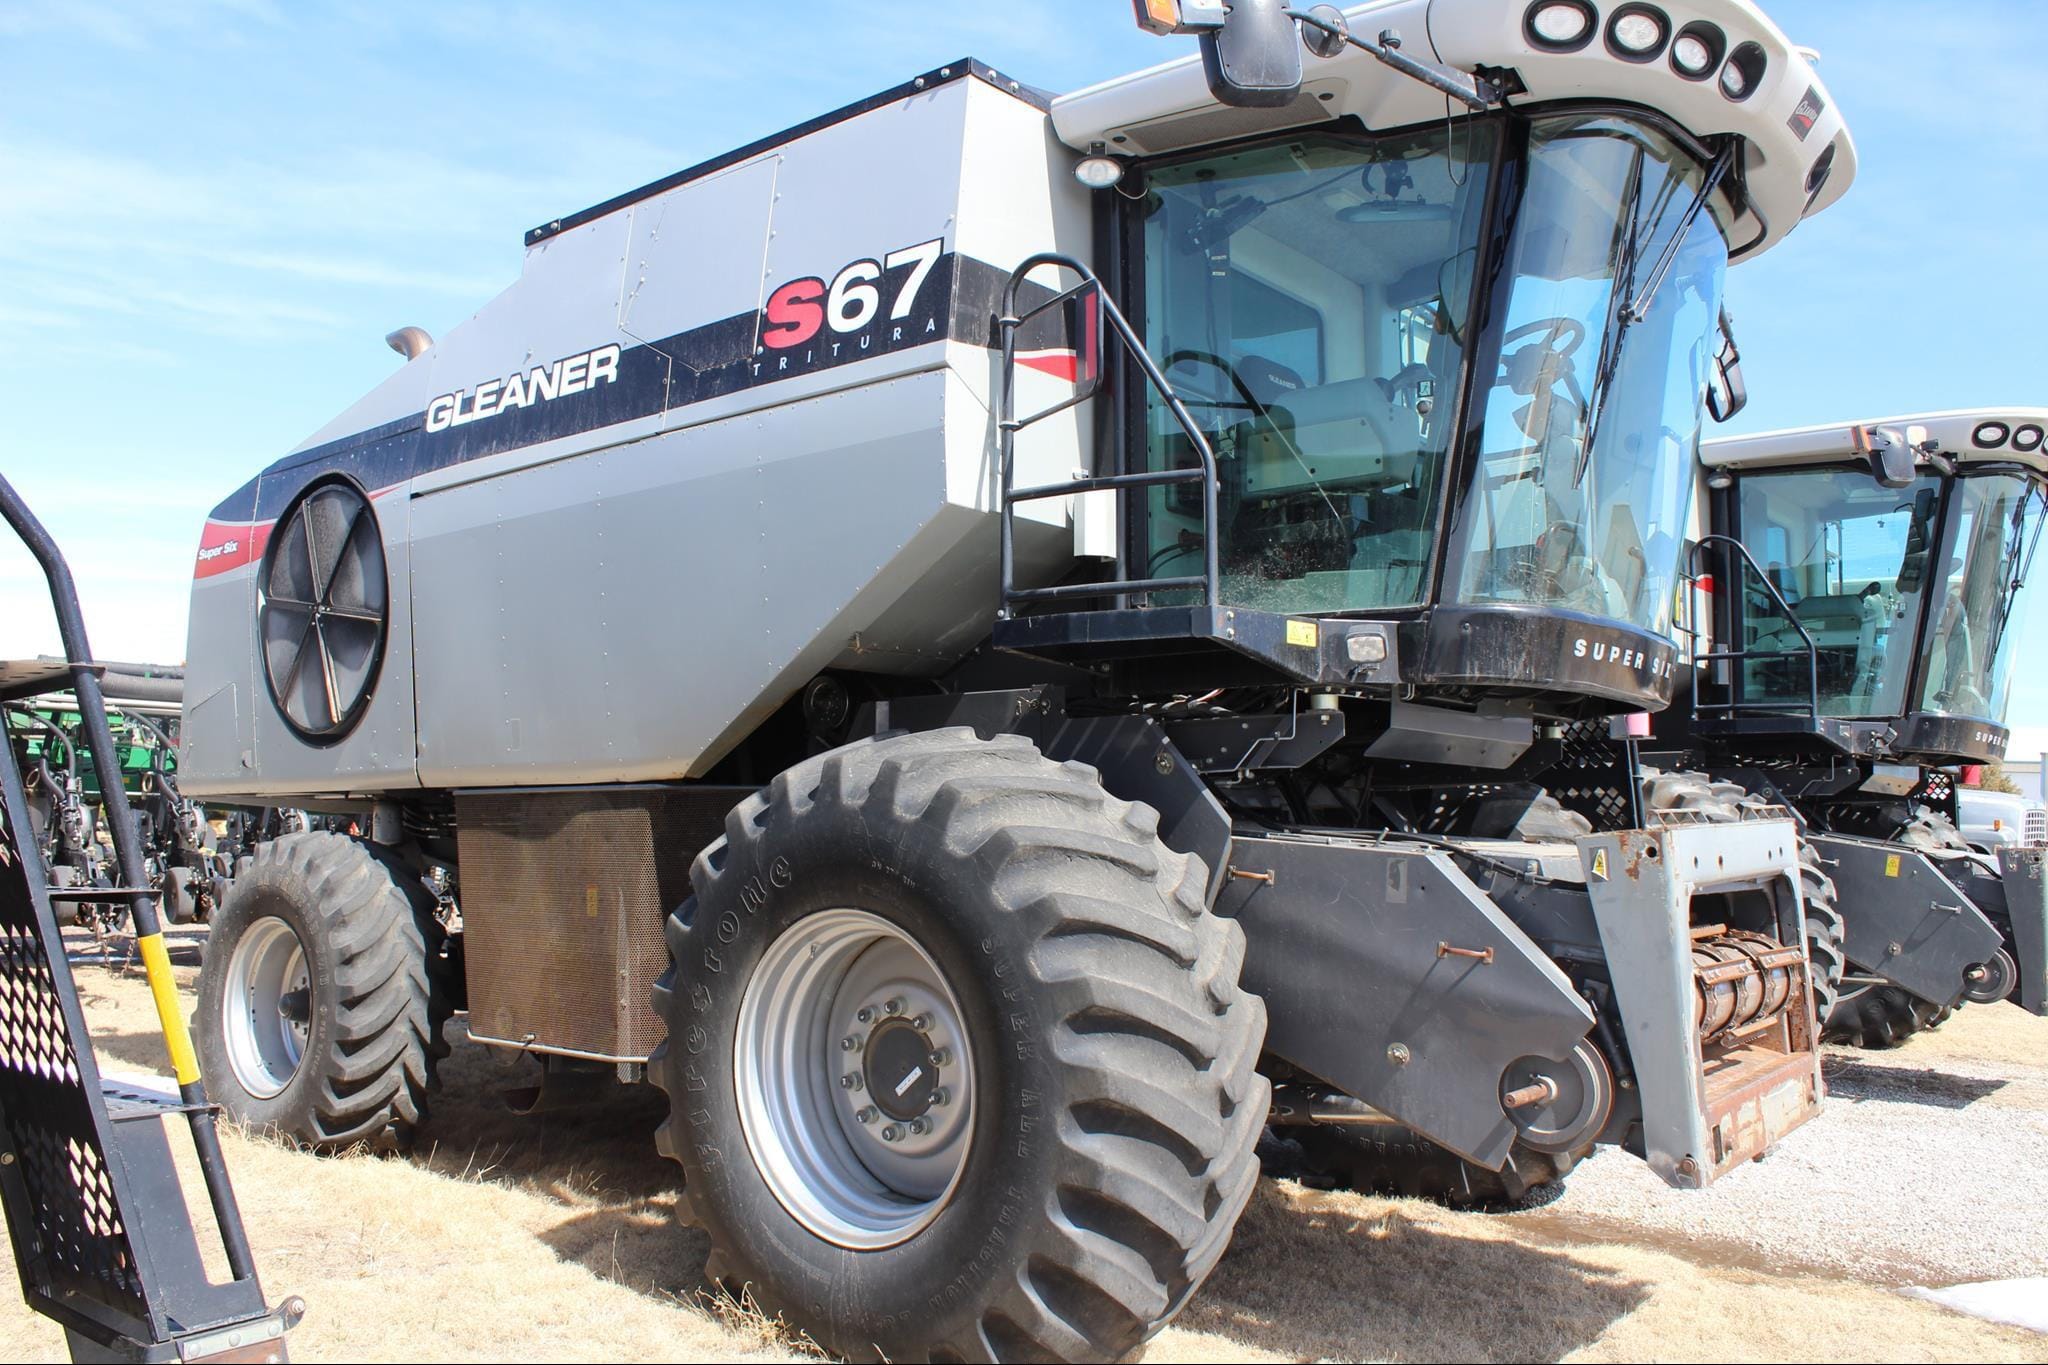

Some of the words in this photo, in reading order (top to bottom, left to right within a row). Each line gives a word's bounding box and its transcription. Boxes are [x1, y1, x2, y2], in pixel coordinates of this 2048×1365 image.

[763, 238, 943, 349] S67
[753, 318, 936, 376] TRITURA
[425, 344, 621, 433] GLEANER
[198, 546, 223, 560] Super
[223, 540, 239, 554] Six
[1574, 638, 1645, 669] SUPER
[1652, 657, 1672, 679] SIX
